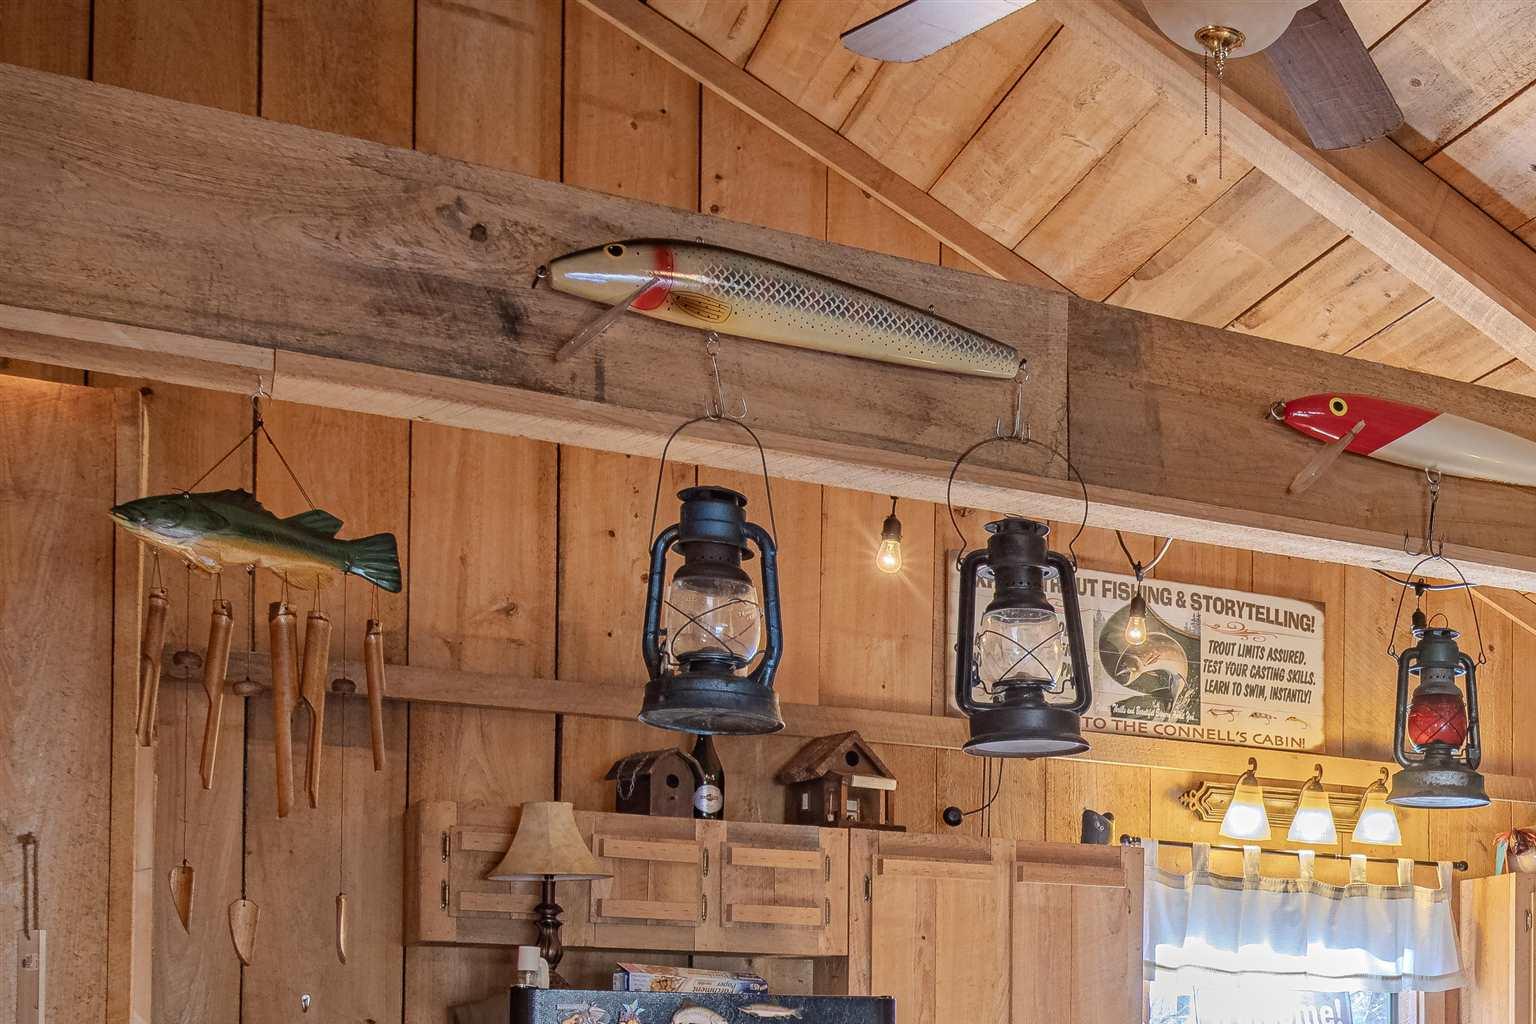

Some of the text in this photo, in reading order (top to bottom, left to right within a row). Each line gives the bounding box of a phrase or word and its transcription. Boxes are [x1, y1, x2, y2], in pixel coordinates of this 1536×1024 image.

[1102, 580, 1172, 606] FISHING
[1176, 592, 1187, 611] &
[1191, 593, 1316, 634] STORYTELLING!
[1208, 640, 1306, 665] TROUT LIMITS ASSURED.
[1203, 659, 1316, 685] TEST YOUR CASTING SKILLS.
[1205, 679, 1312, 704] LEARN TO SWIM, INSTANTLY!
[1082, 716, 1306, 748] TO THE CONNELL'S CABIN!
